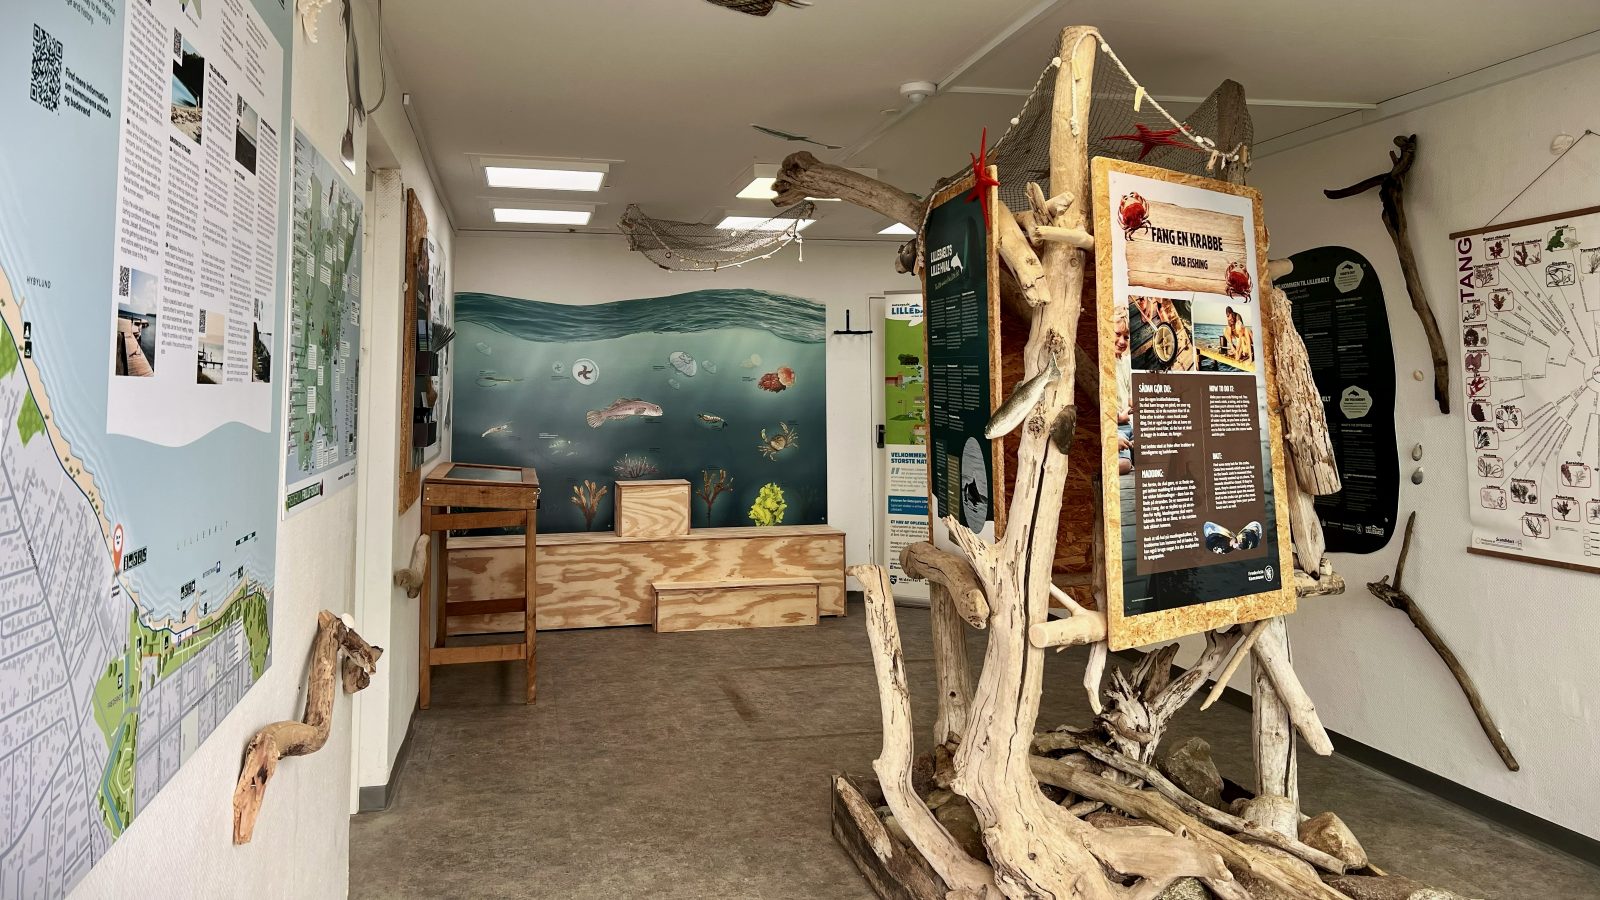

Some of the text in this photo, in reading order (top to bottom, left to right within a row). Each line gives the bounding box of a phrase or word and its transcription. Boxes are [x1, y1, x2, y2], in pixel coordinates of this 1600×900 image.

[66, 67, 75, 82] Find
[86, 82, 109, 105] information
[1151, 227, 1223, 251] FANG EN KRABBE
[1171, 255, 1208, 270] CRAB FISHING
[1458, 237, 1474, 303] TANG
[1139, 383, 1171, 394] SÅDAN GØR DU:
[1141, 469, 1164, 479] MADDING:
